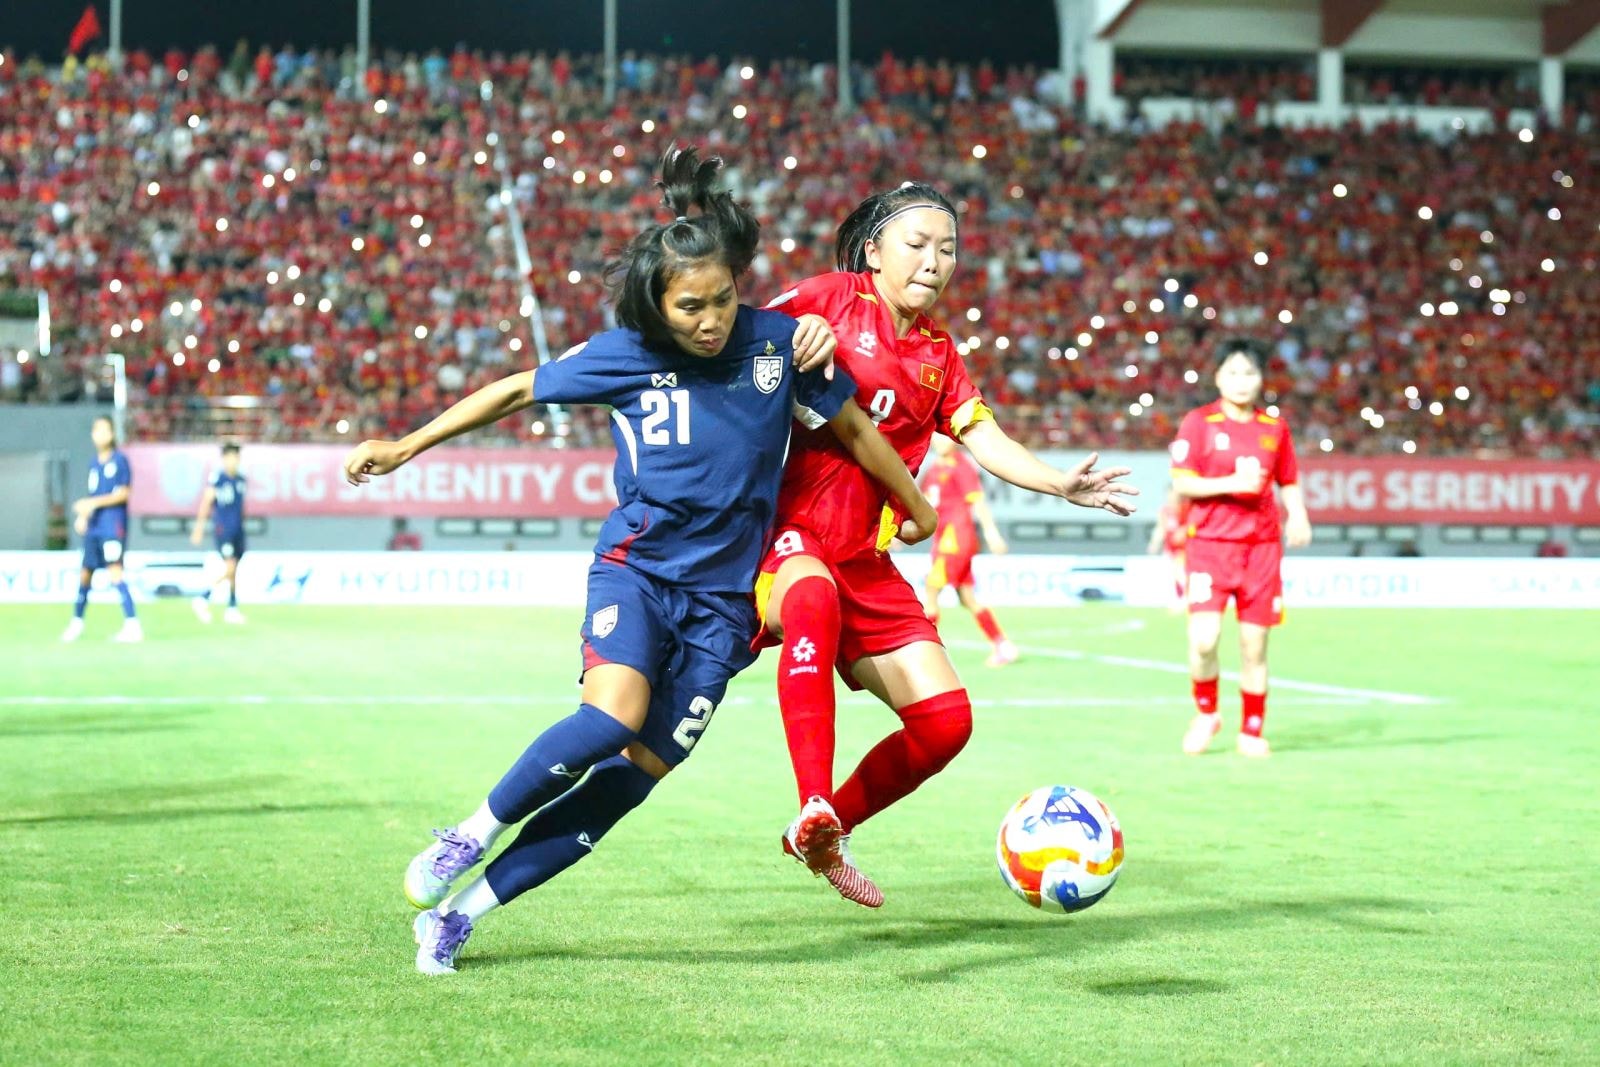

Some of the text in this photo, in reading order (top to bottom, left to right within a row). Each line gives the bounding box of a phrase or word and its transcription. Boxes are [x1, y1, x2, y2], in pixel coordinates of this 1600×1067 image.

[640, 389, 691, 446] 21
[251, 463, 327, 502] SIG
[1301, 469, 1377, 511] SIG
[1383, 469, 1588, 512] SERENITY
[774, 530, 805, 558] 9
[672, 696, 714, 752] 2
